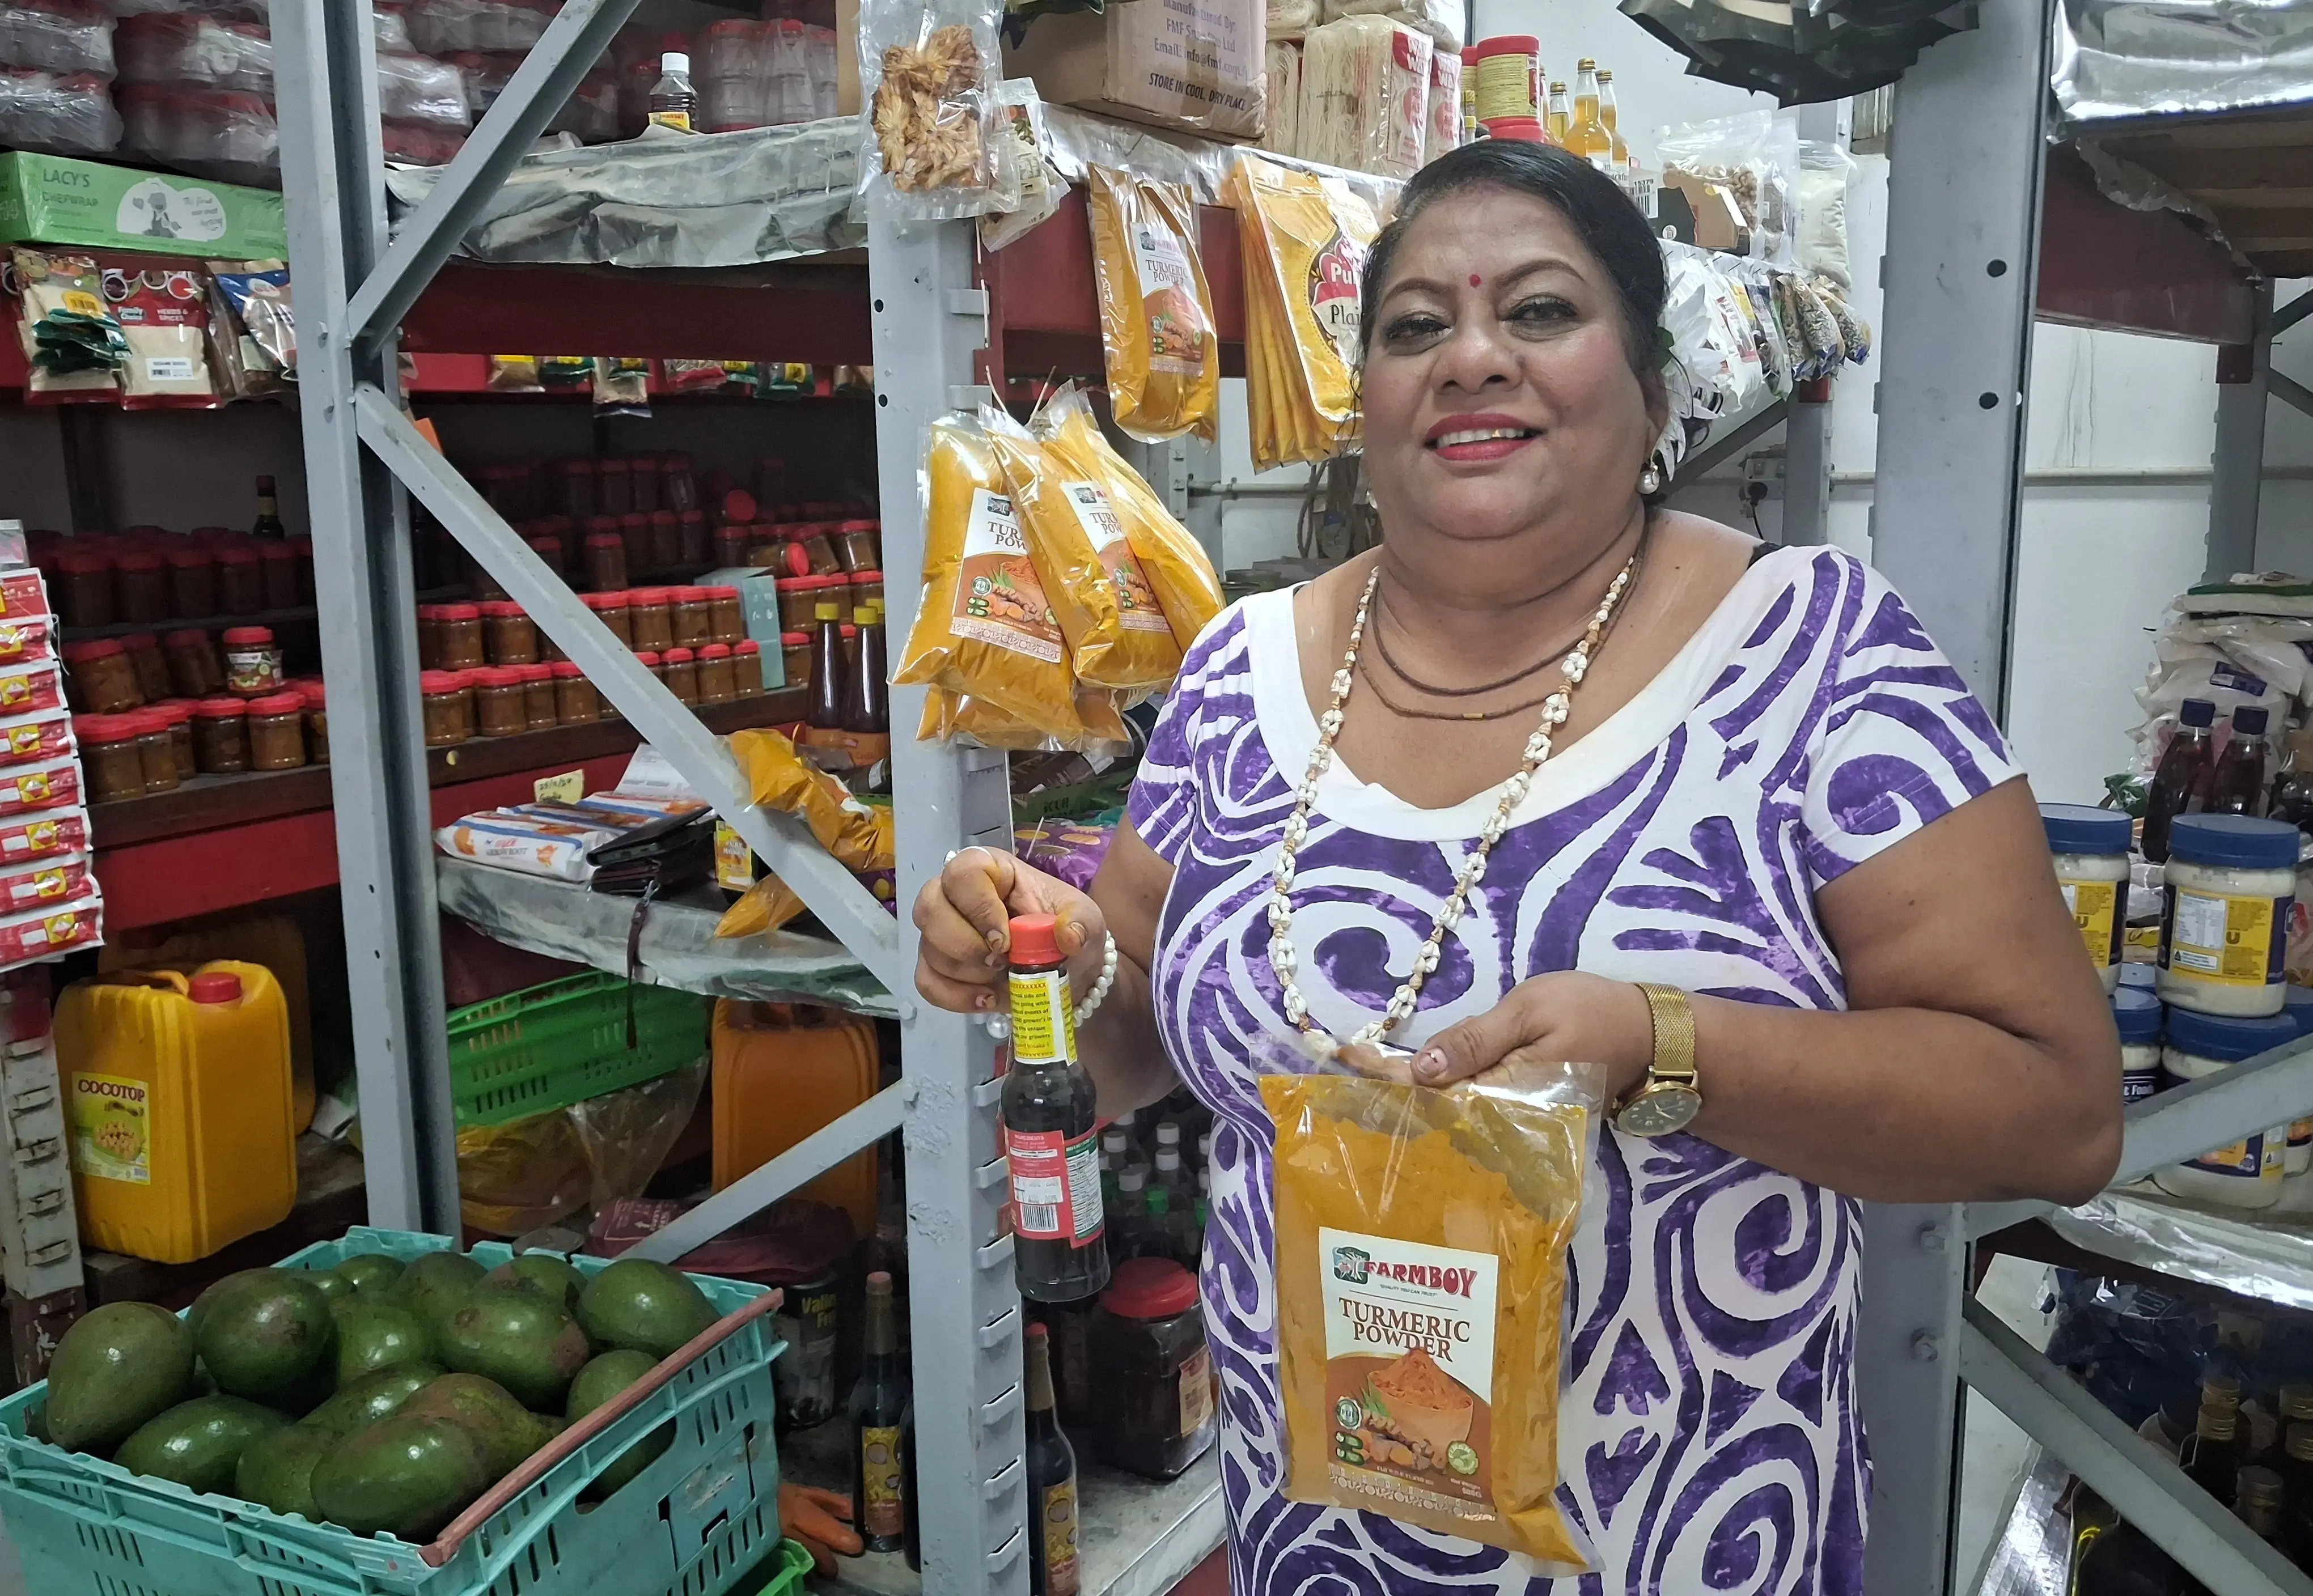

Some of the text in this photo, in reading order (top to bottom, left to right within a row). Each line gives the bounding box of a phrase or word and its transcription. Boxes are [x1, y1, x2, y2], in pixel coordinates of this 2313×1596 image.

[1166, 18, 1184, 35] FMF
[1223, 37, 1235, 53] Ltd
[1149, 73, 1175, 91] STORE
[1175, 80, 1183, 94] IN
[1209, 90, 1225, 104] DRY
[43, 168, 90, 188] LACY'S
[1145, 260, 1188, 279] TURMERIC
[1154, 271, 1184, 286] POWDER
[1330, 262, 1354, 285] Pu
[78, 1079, 145, 1102] COCOTOP
[1363, 1261, 1478, 1300] FARMBOY
[1338, 1297, 1470, 1343] TURMERIC
[1352, 1321, 1453, 1362] POWDER
